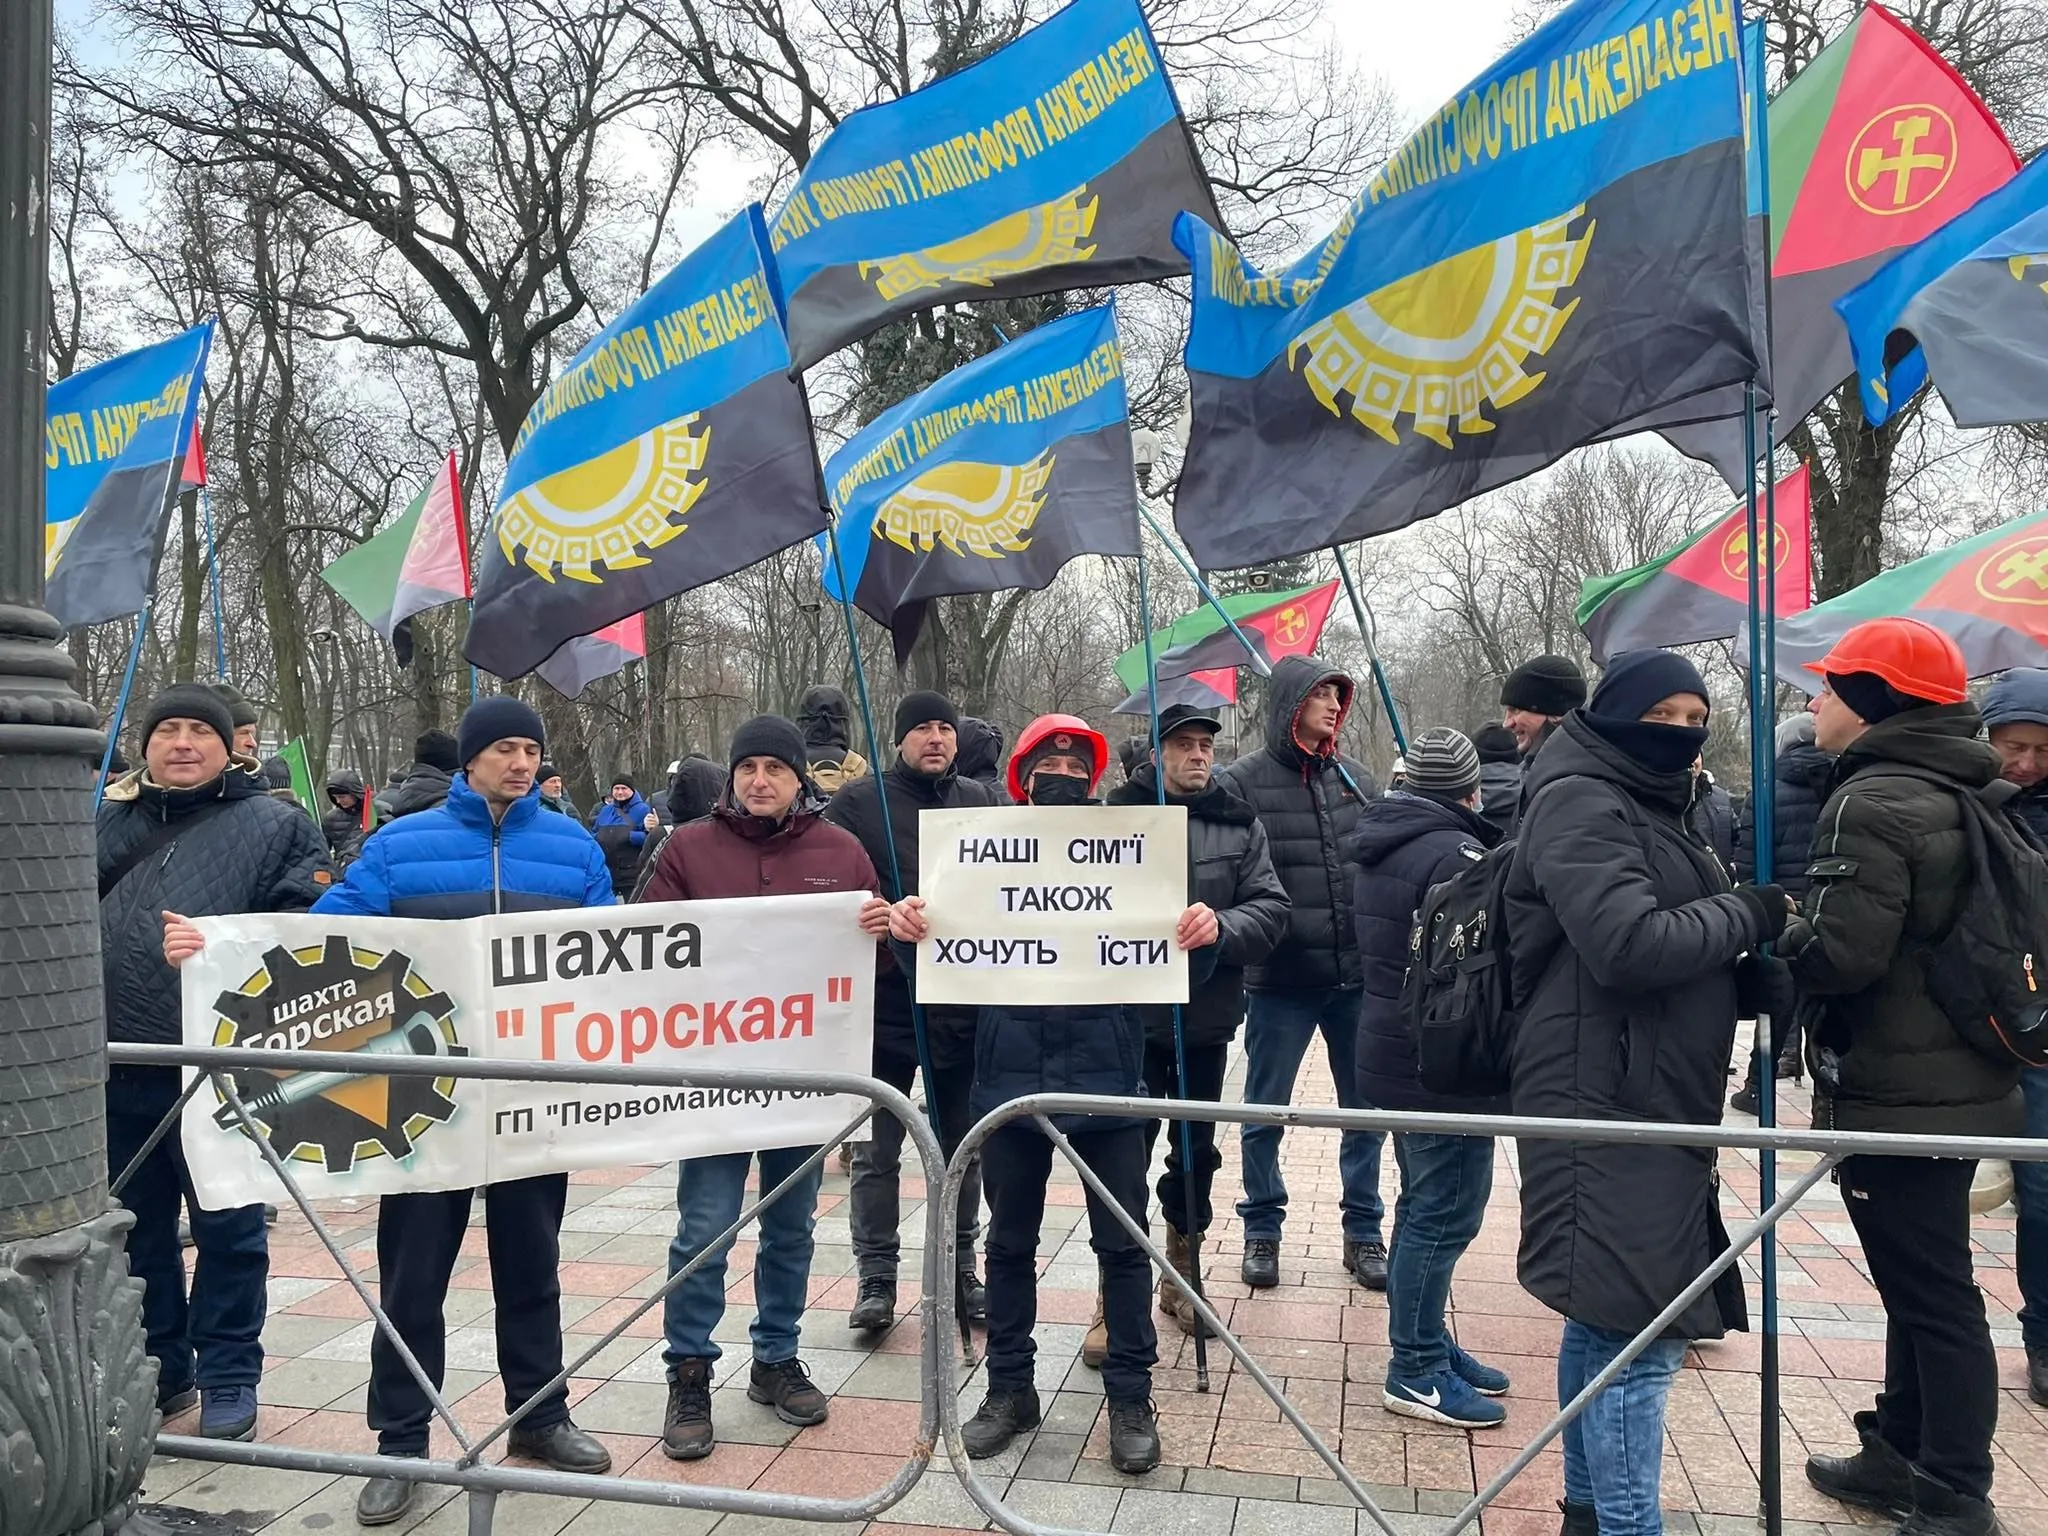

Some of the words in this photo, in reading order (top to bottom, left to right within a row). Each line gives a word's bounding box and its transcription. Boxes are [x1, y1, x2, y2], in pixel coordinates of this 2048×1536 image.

[958, 838, 1039, 864] НАШІ
[1000, 886, 1113, 912] ТАКОЖ
[491, 921, 702, 987] шахта
[935, 938, 1058, 965] ХОЧУТЬ
[1097, 935, 1169, 966] ЇСТИ
[272, 978, 358, 1025] шахта
[495, 1107, 534, 1135] ГП
